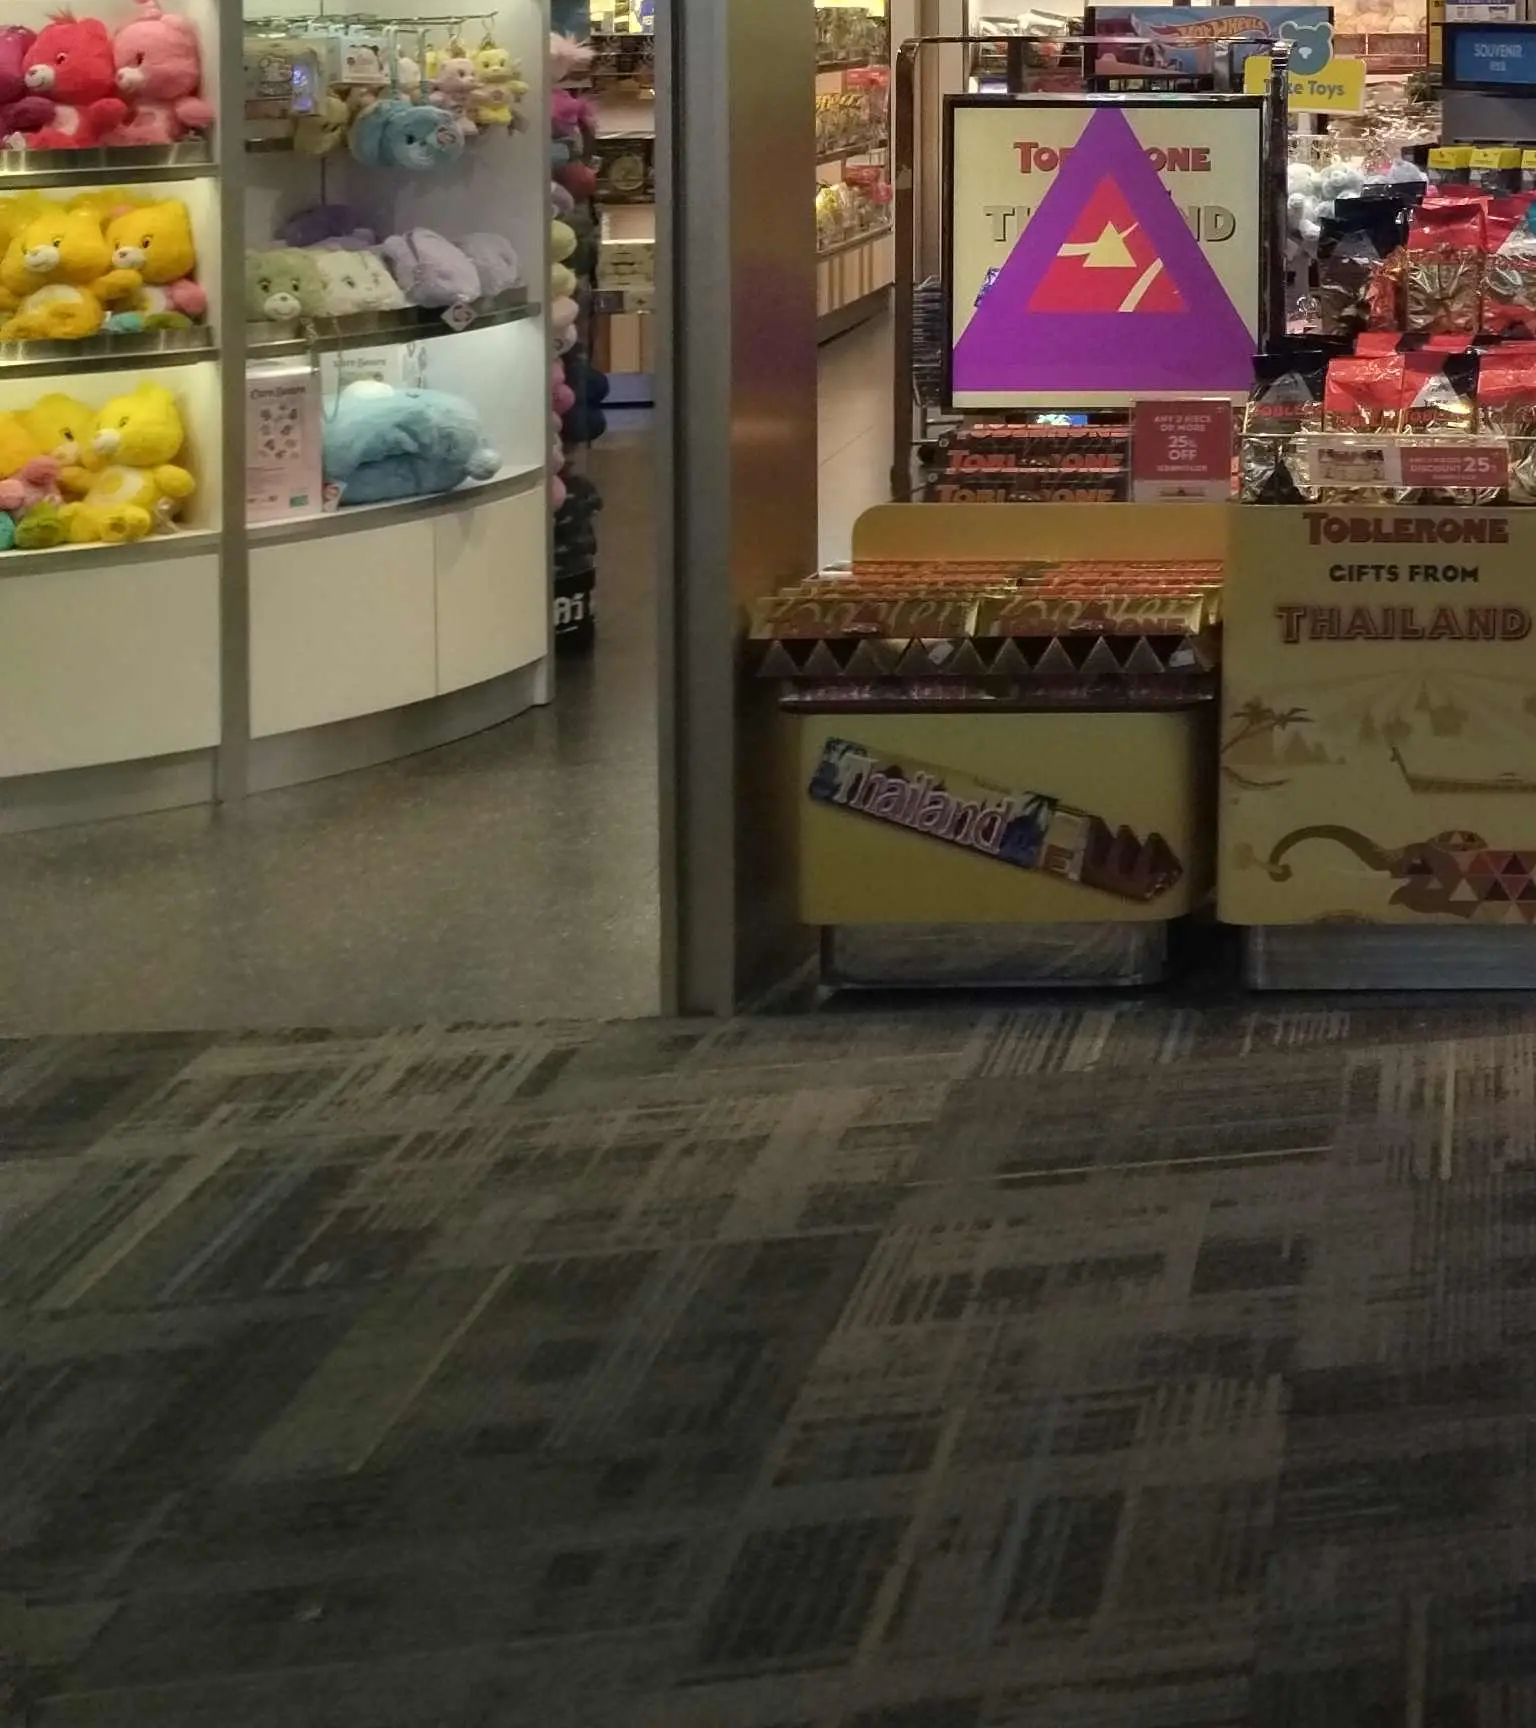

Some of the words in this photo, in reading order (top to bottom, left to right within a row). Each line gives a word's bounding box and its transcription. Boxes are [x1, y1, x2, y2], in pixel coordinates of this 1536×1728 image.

[1474, 44, 1523, 58] SOUVENIR
[1307, 79, 1345, 96] Toys
[1168, 449, 1198, 460] OFF
[1410, 463, 1463, 472] DISCOUNT
[1303, 512, 1509, 545] TOBLERONE
[1329, 564, 1399, 582] GIFTS
[1409, 564, 1479, 582] FROM
[1275, 603, 1533, 644] THAILAND
[833, 753, 1014, 855] Thailand
